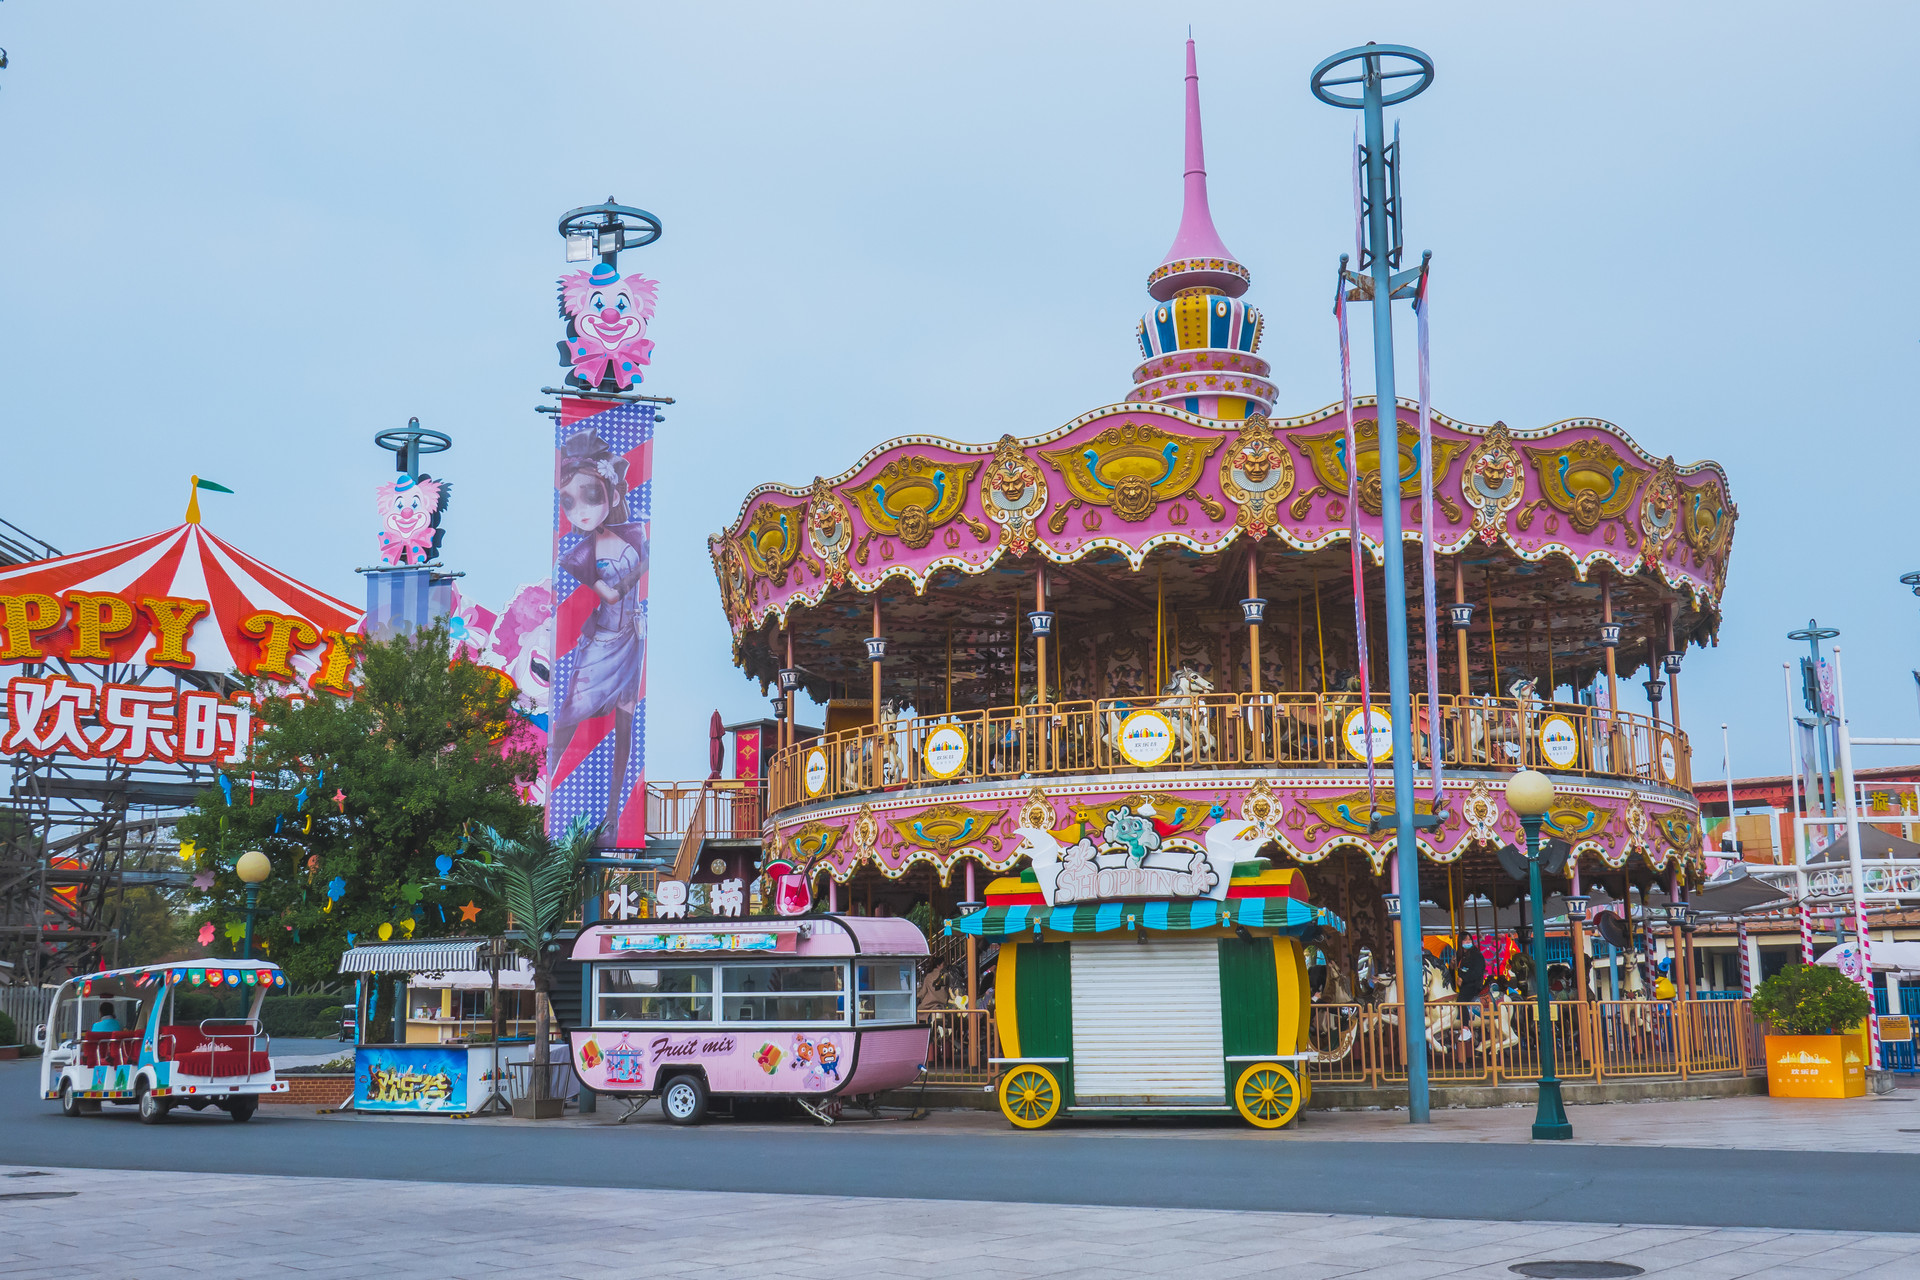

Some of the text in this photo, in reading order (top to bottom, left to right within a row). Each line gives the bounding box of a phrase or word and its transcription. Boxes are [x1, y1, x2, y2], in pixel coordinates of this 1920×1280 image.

[8, 678, 255, 765] 欢乐时
[607, 877, 744, 920] 水果捞
[1055, 868, 1194, 902] SHOPPING
[651, 1036, 734, 1063] Fruit mix
